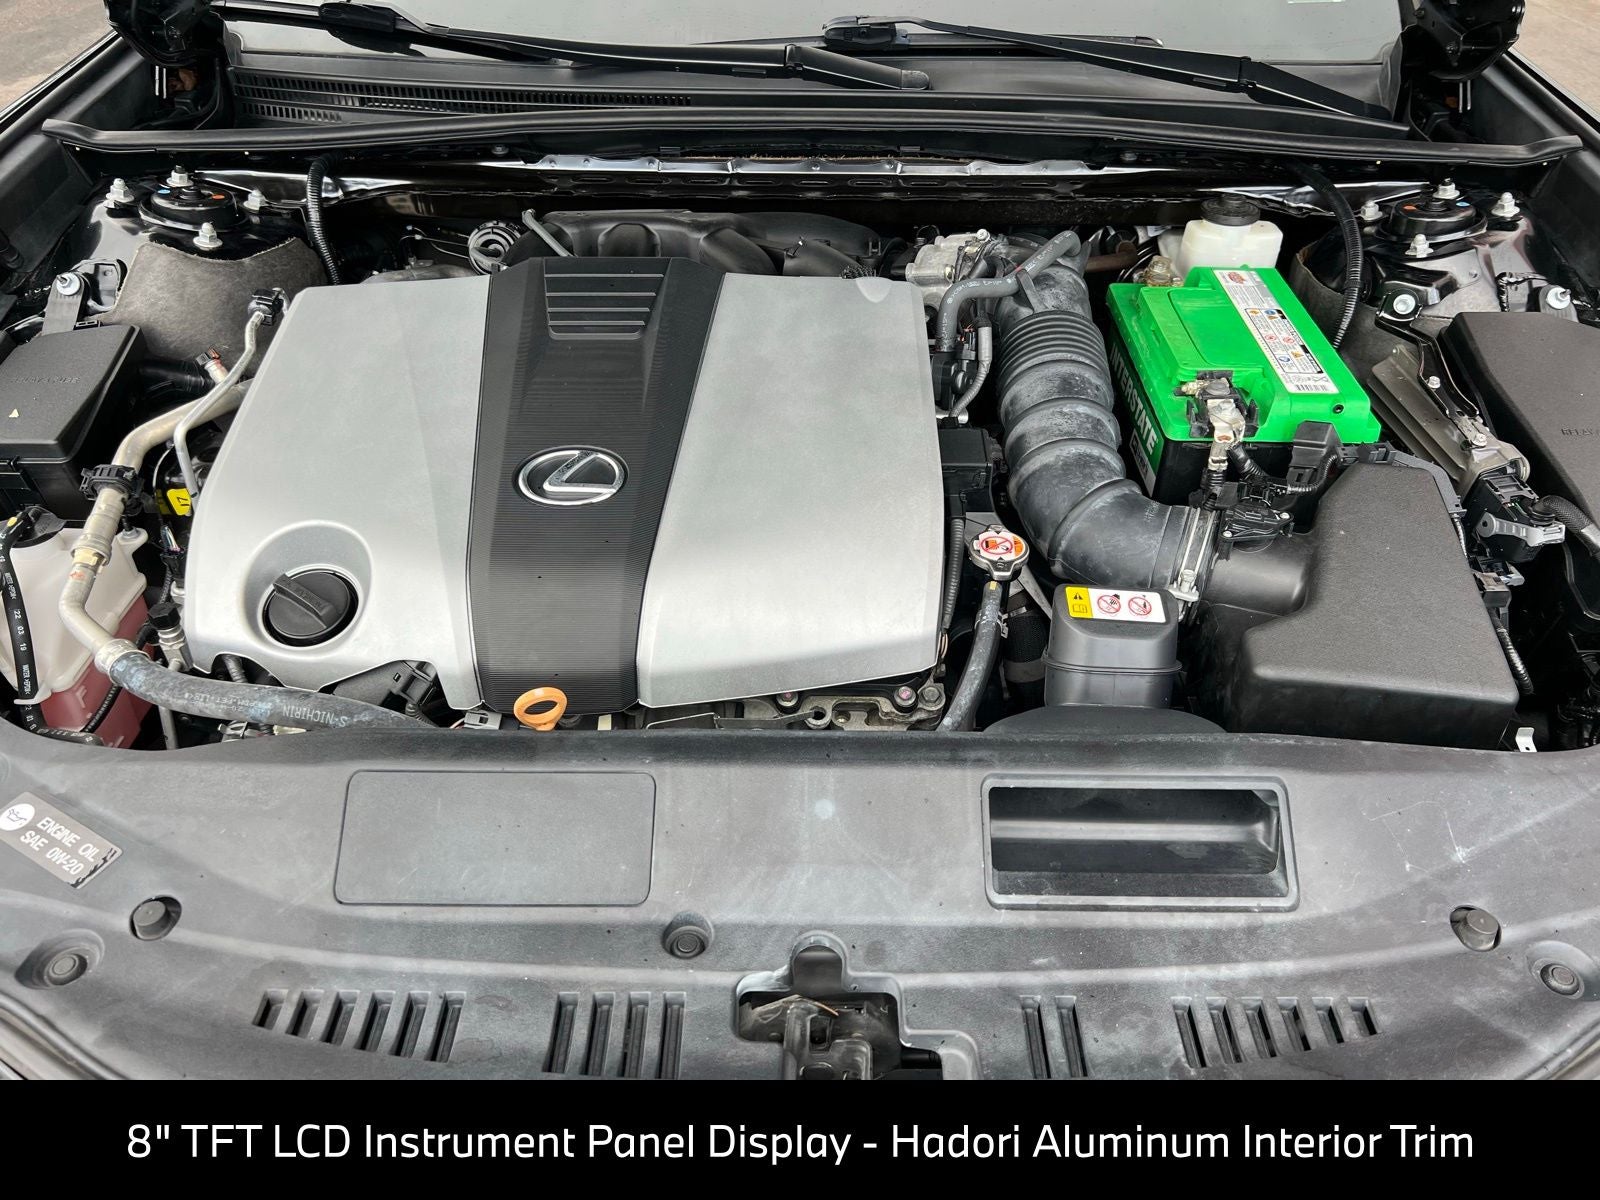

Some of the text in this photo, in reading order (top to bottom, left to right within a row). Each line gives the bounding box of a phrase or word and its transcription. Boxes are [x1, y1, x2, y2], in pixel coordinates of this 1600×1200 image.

[1109, 343, 1158, 456] INTERSTATE
[20, 830, 84, 875] SAE 0W-20
[36, 816, 100, 862] ENGINE OIL
